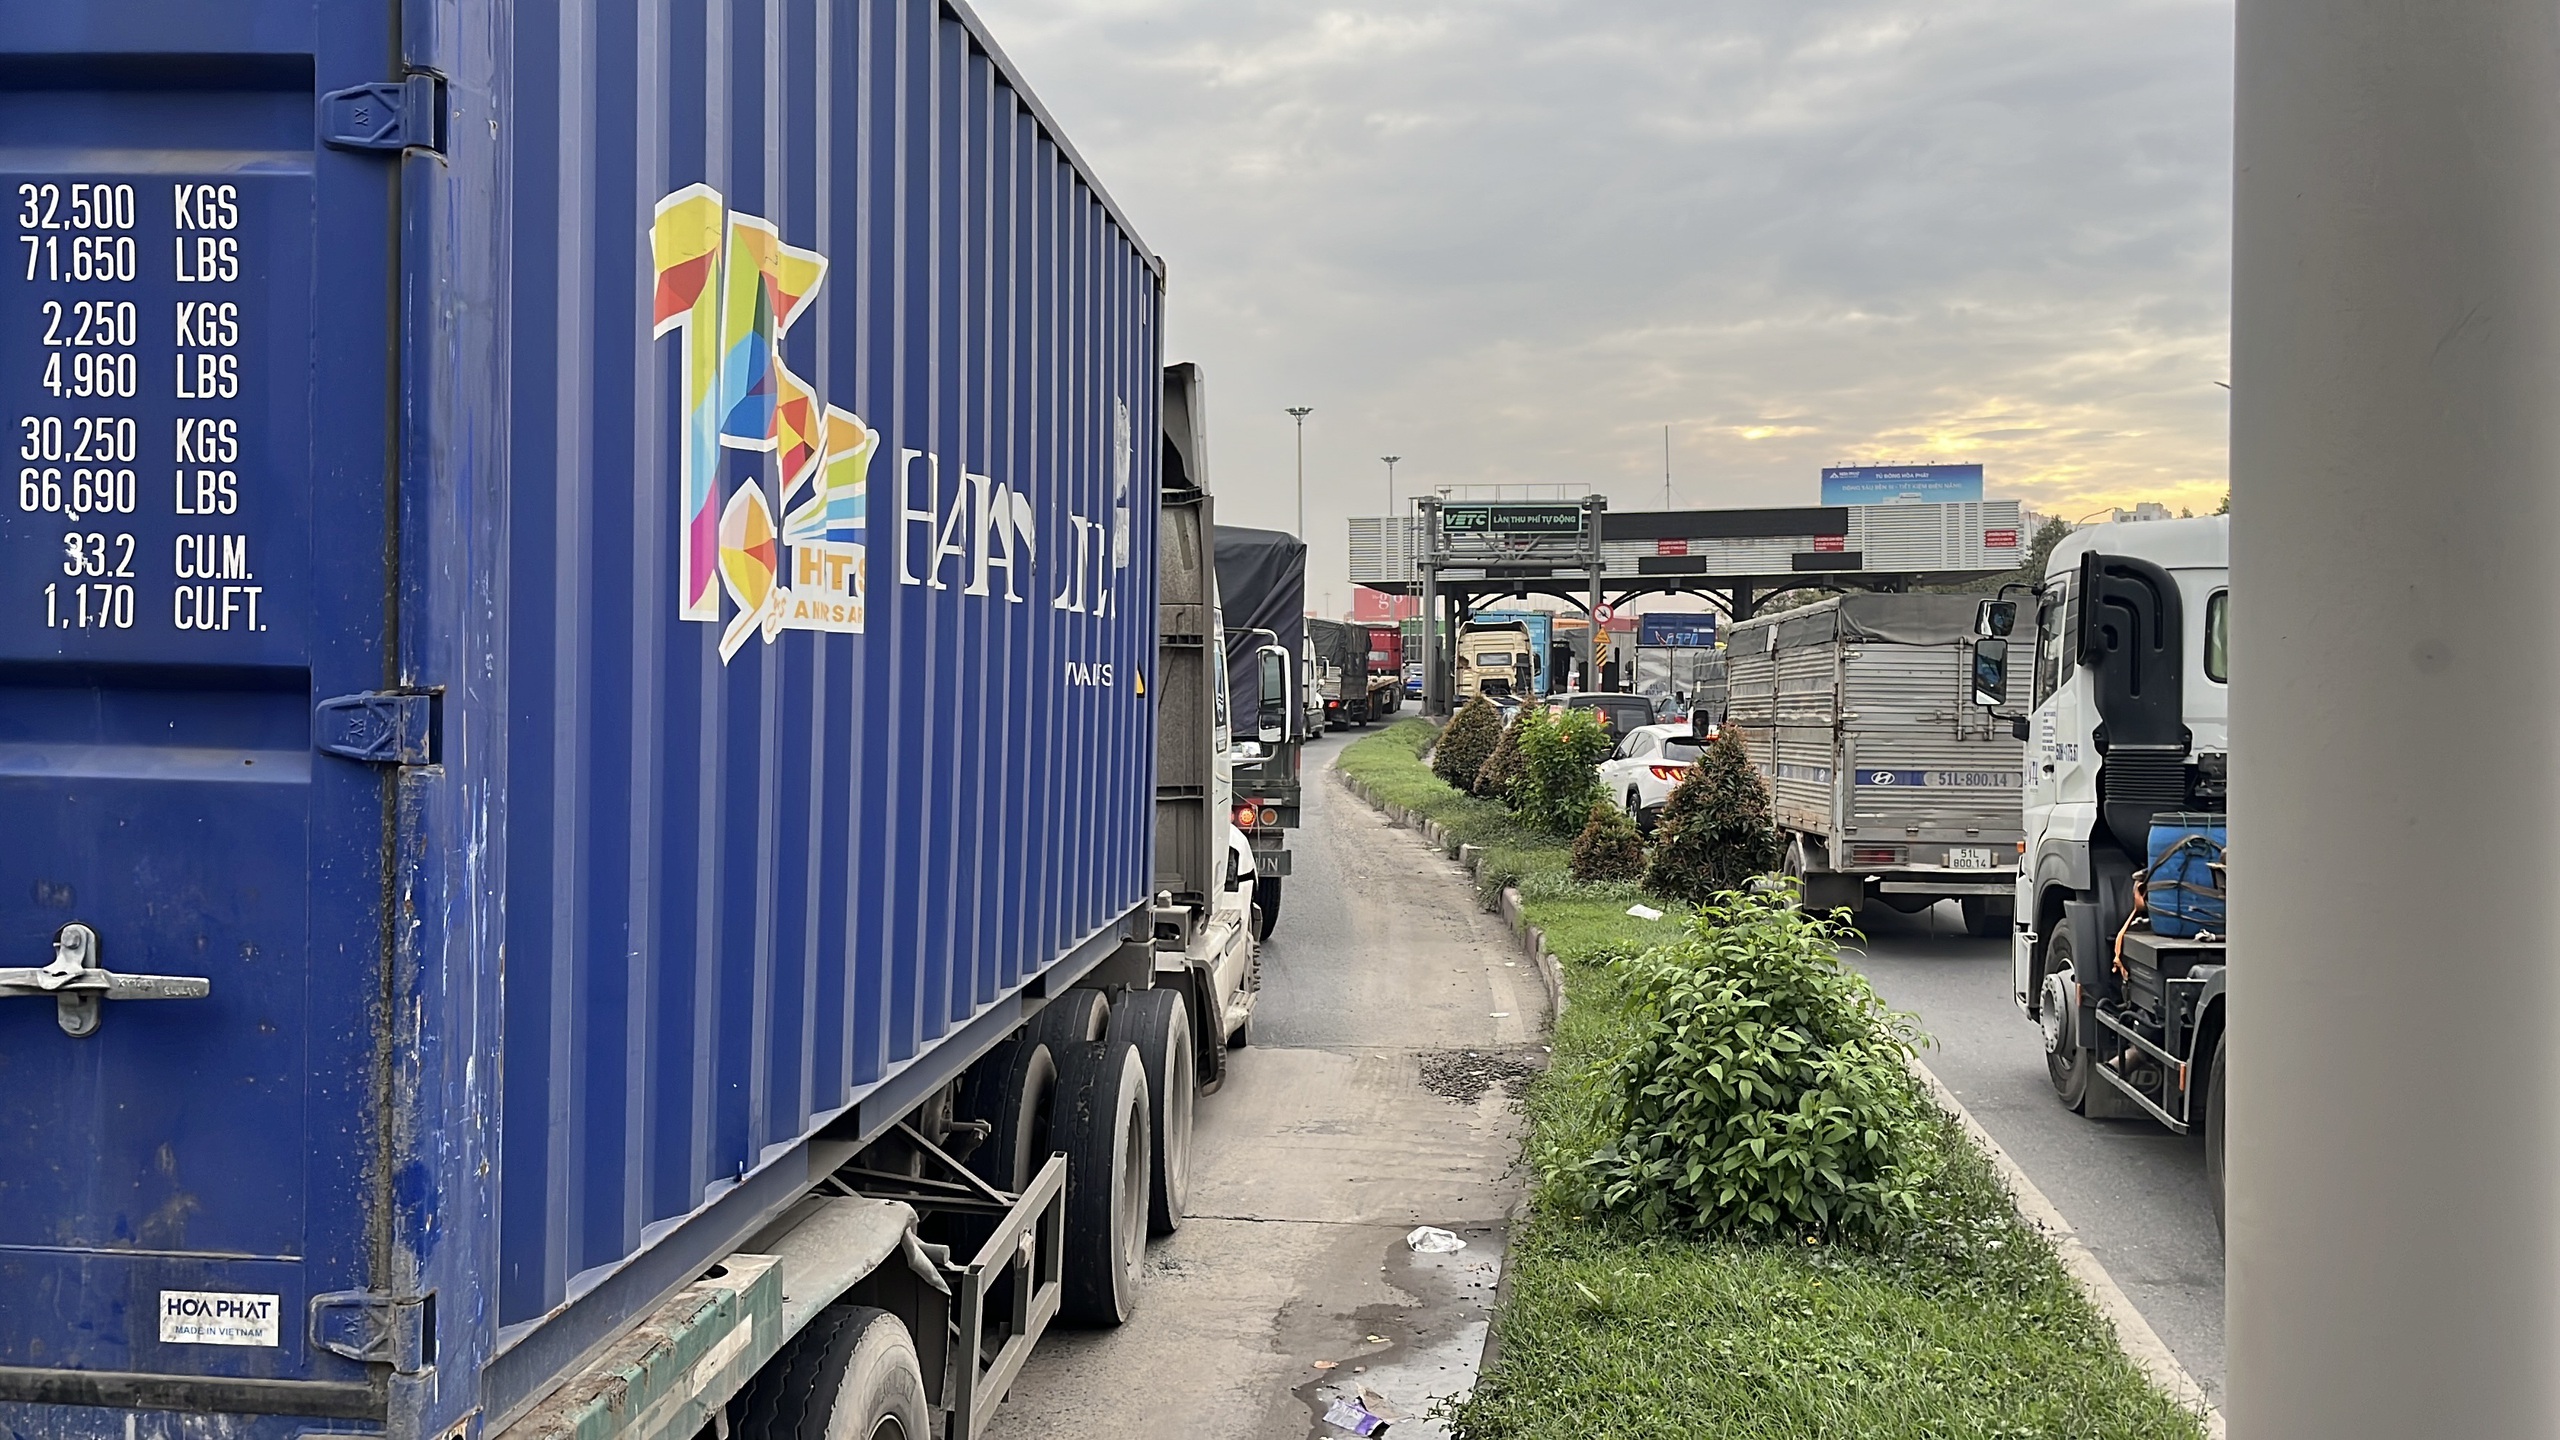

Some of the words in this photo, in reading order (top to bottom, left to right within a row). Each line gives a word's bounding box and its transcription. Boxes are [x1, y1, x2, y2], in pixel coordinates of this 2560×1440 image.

[19, 184, 135, 230] 32,500
[174, 184, 239, 230] KGS
[19, 236, 136, 283] 71,650
[175, 236, 240, 282] LBS
[42, 301, 136, 348] 2,250
[175, 302, 239, 347] KGS
[42, 352, 136, 399] 4,960
[175, 354, 239, 399] LBS
[20, 417, 136, 463] 30,250
[175, 418, 238, 464] KGS
[20, 468, 136, 515] 66,690
[175, 470, 238, 514] LBS
[1446, 514, 1487, 525] VETC
[1493, 514, 1512, 523] LÀN
[1527, 515, 1541, 523] PHÍ
[1541, 516, 1553, 525] TỰ
[1554, 515, 1576, 525] ĐỘNG
[62, 533, 135, 578] 33.2
[175, 535, 253, 580] CU.M.
[44, 583, 134, 629] 1,170
[174, 586, 267, 631] CU.FT.
[1938, 772, 2008, 786] 51L-800.14
[1953, 859, 1987, 868] 800.14
[1960, 849, 1979, 858] 51L
[175, 1325, 204, 1335] MADE
[206, 1327, 216, 1335] IN
[219, 1327, 263, 1337] VIETNAM
